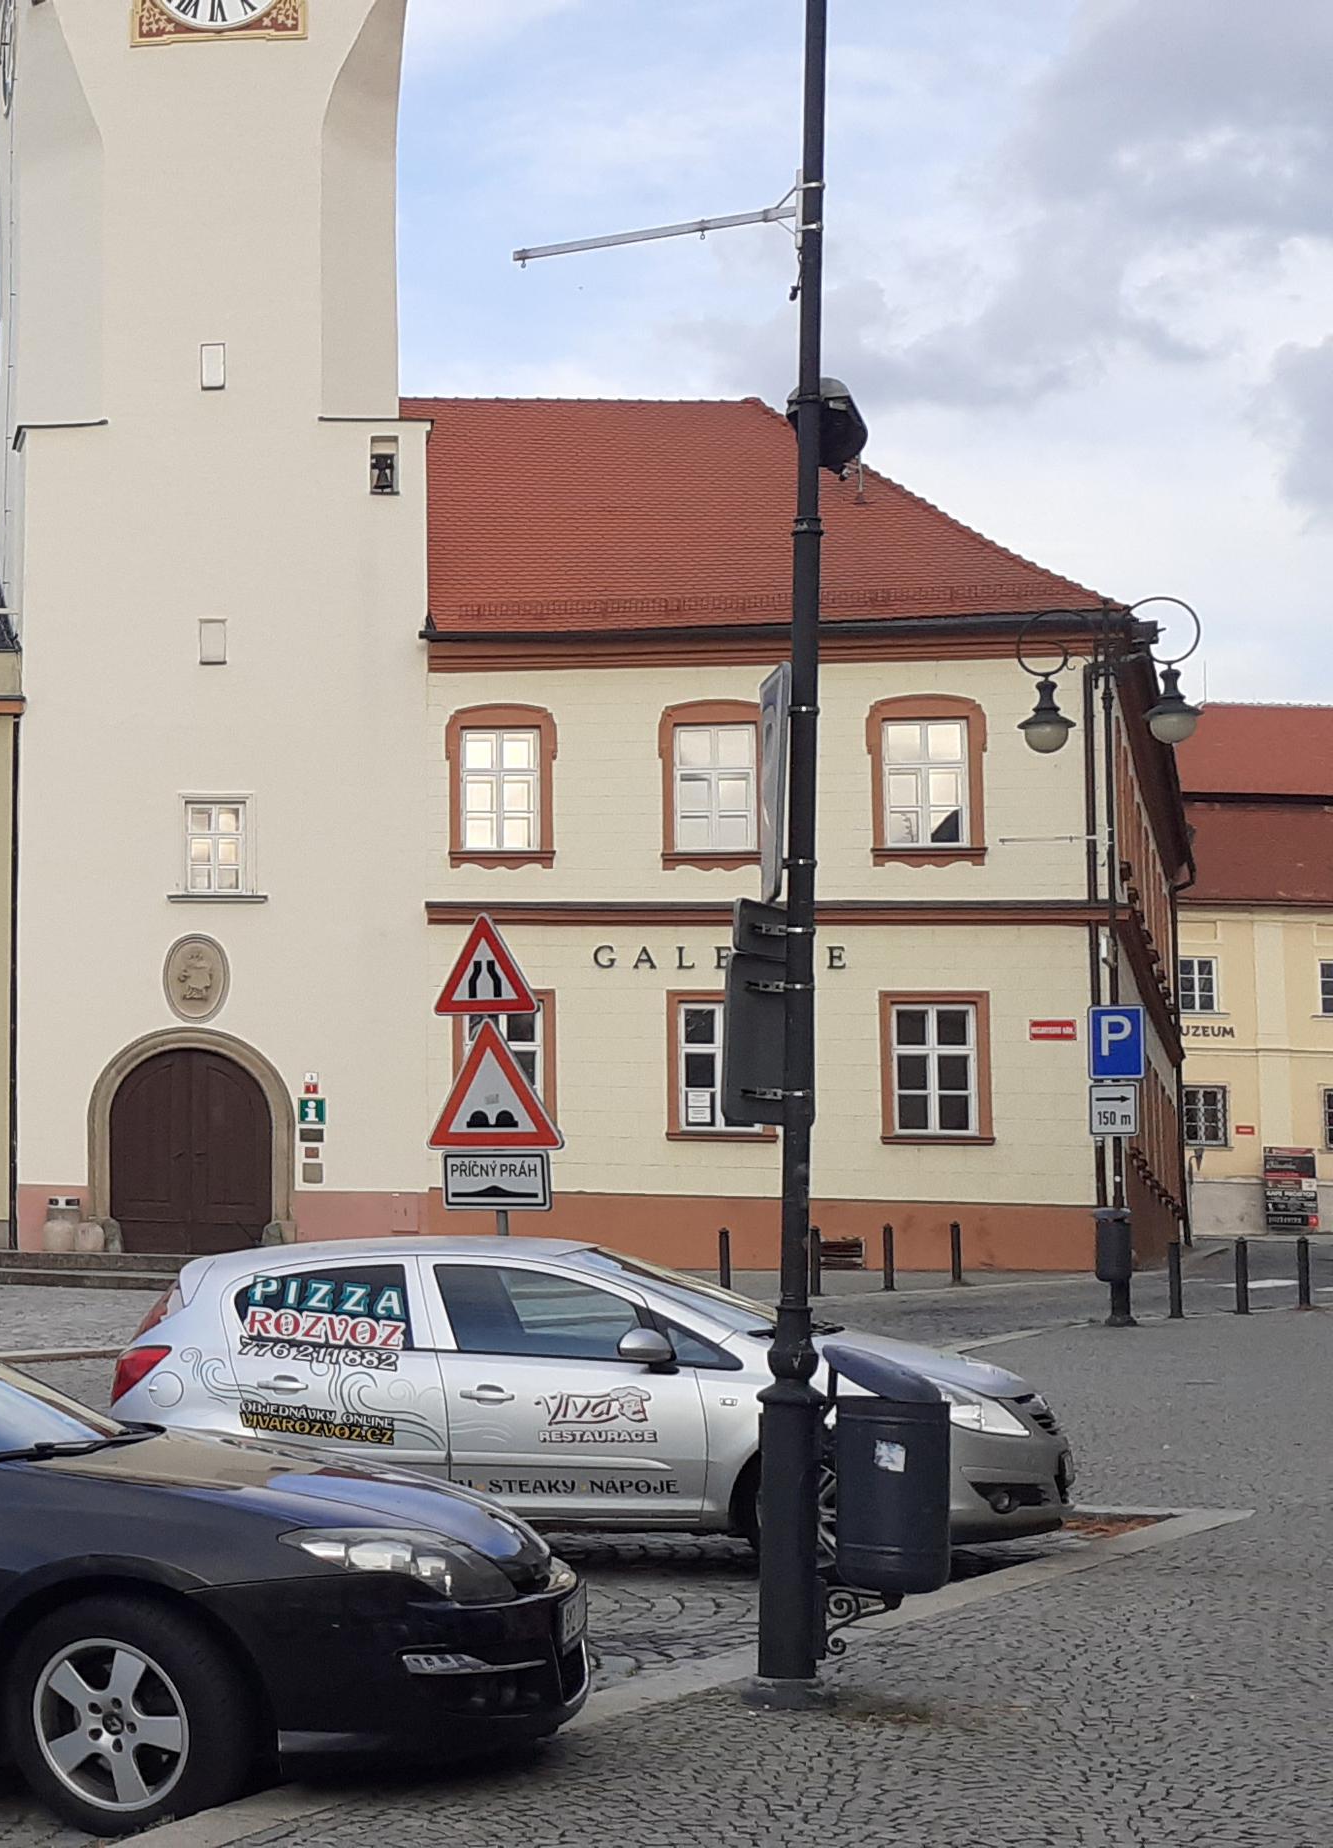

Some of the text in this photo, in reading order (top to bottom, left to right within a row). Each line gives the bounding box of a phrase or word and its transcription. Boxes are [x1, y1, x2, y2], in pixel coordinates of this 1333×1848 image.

[593, 944, 847, 970] GALEE
[1100, 1015, 1132, 1056] P
[1180, 1024, 1235, 1039] UZEUM
[1097, 1110, 1131, 1126] 150 m
[450, 1160, 538, 1177] PŘÍČNÝ PRÁH
[248, 1275, 406, 1319] PIZZA
[243, 1306, 406, 1350] ROZVOZ
[238, 1335, 400, 1373] 776 211 882
[240, 1400, 394, 1428] OBJEDNÁVKY ONLINE
[240, 1411, 395, 1446] VIVAROZVOZ.CZ
[539, 1430, 659, 1443] RESTAURACE
[488, 1479, 576, 1494] STEAKY
[590, 1476, 681, 1494] NÁPOJE
